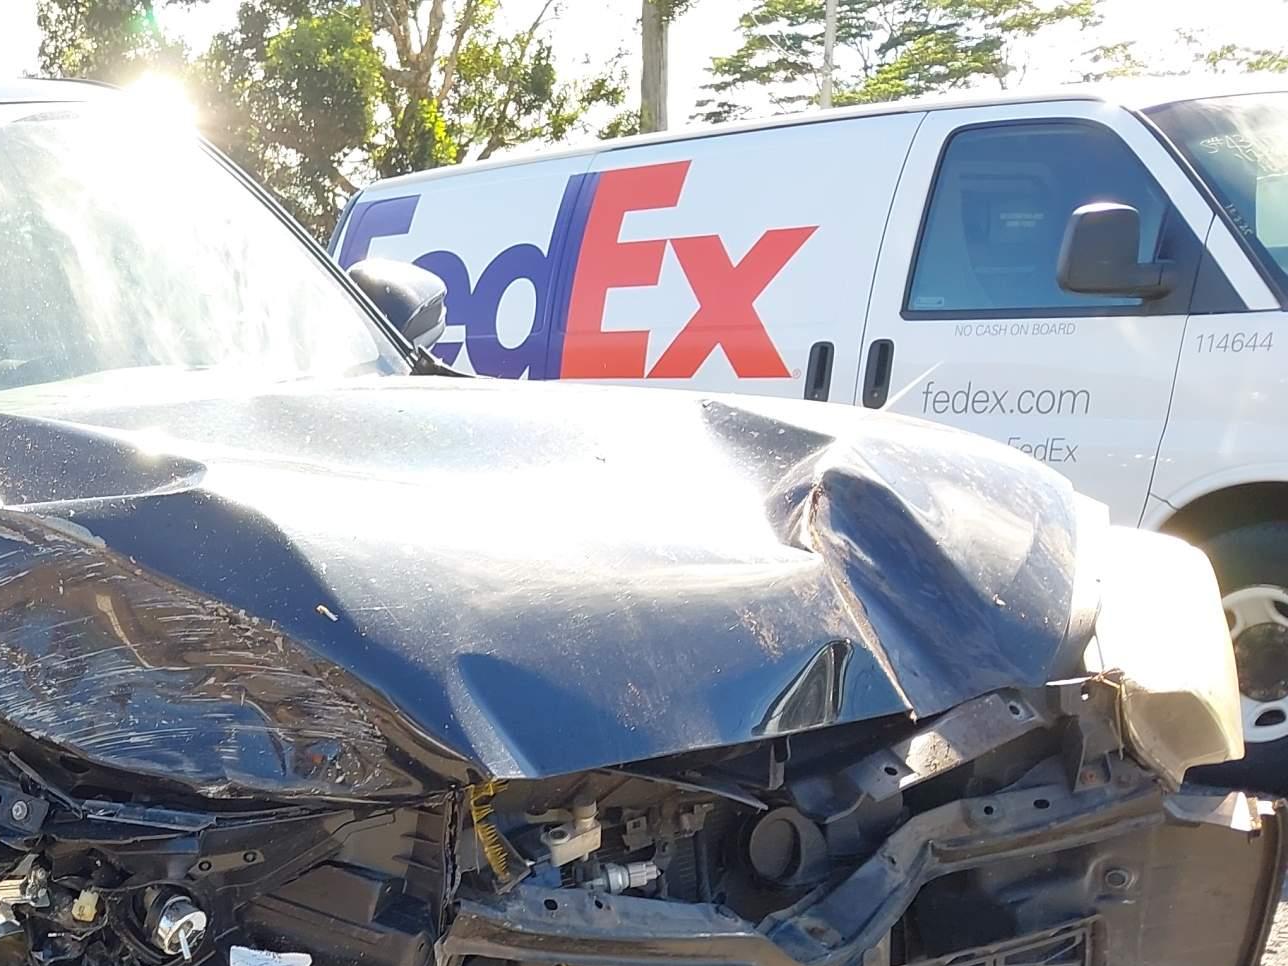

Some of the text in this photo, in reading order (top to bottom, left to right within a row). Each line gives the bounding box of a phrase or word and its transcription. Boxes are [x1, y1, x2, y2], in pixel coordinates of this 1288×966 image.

[954, 322, 1076, 337] NO CASH ON BOARD
[1196, 331, 1273, 352] 114644
[922, 380, 1090, 415] fedex.com
